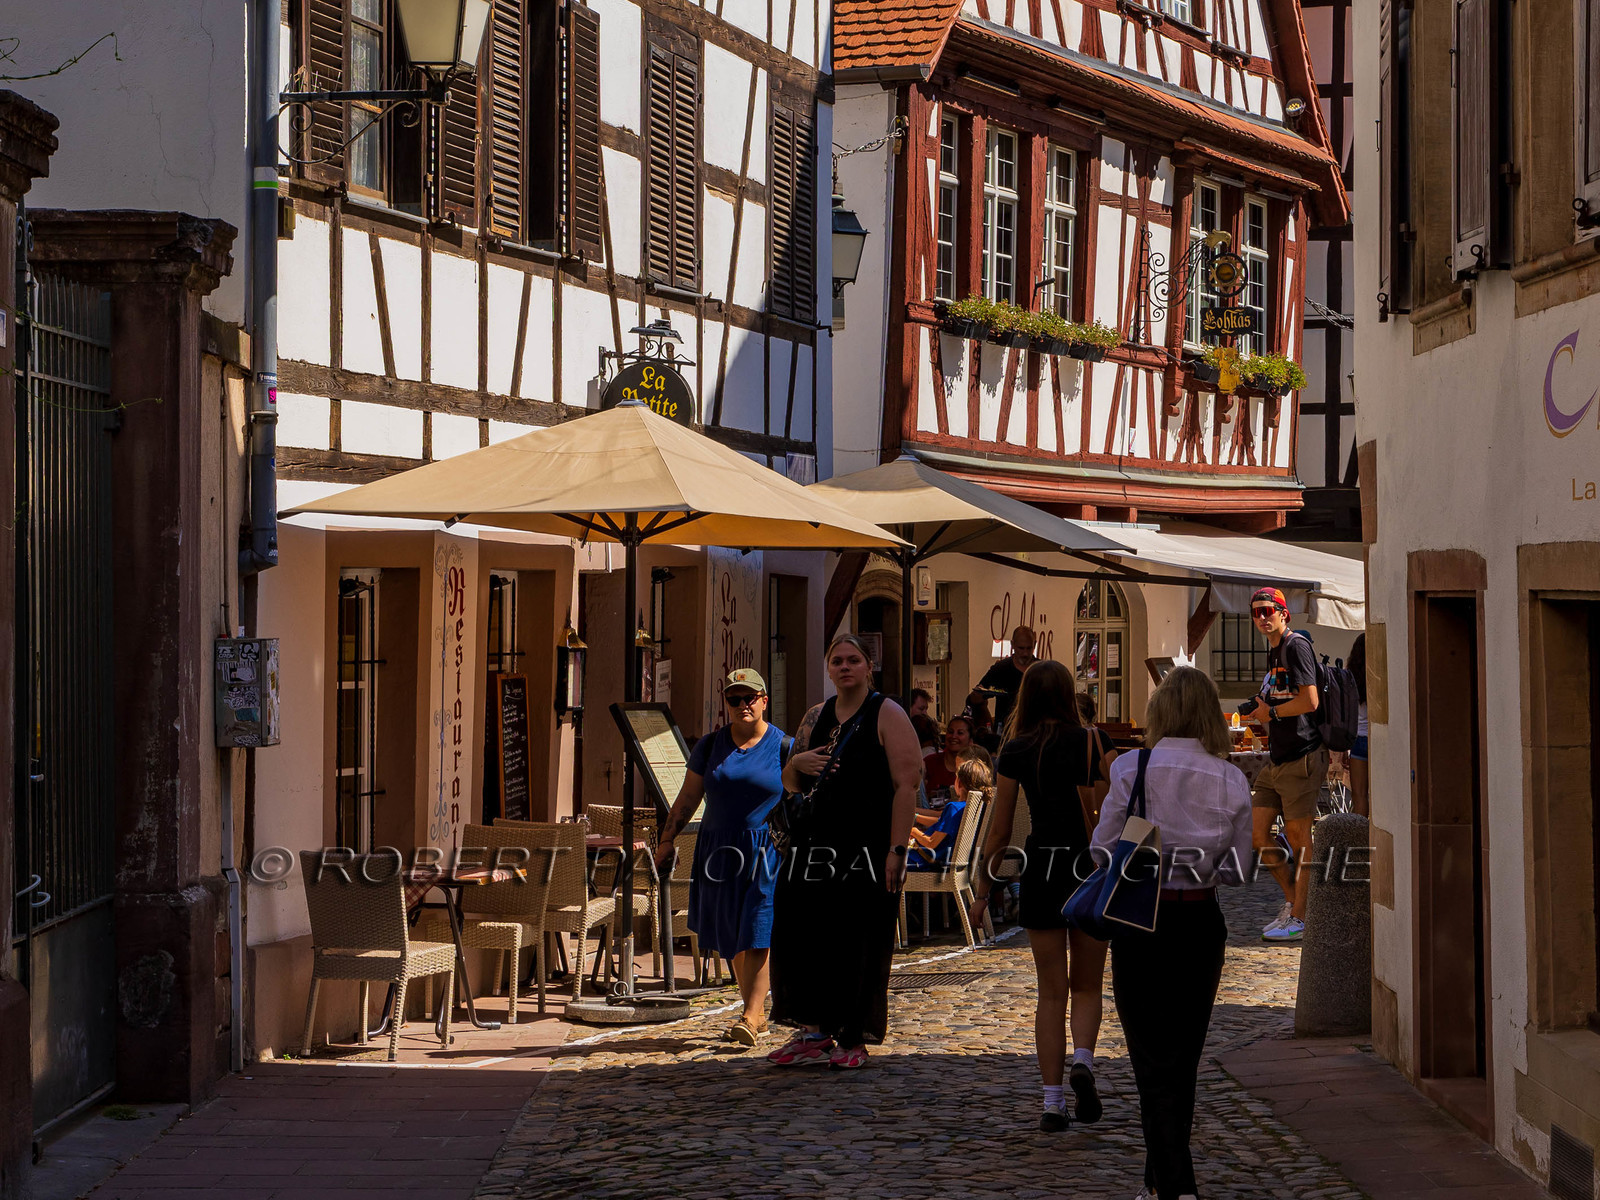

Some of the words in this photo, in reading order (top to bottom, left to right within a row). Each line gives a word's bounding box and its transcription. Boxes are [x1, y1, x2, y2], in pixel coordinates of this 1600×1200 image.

[640, 366, 666, 391] La
[622, 387, 678, 418] tite
[1572, 478, 1597, 501] La
[721, 572, 737, 626] La
[449, 566, 466, 852] Restaurant
